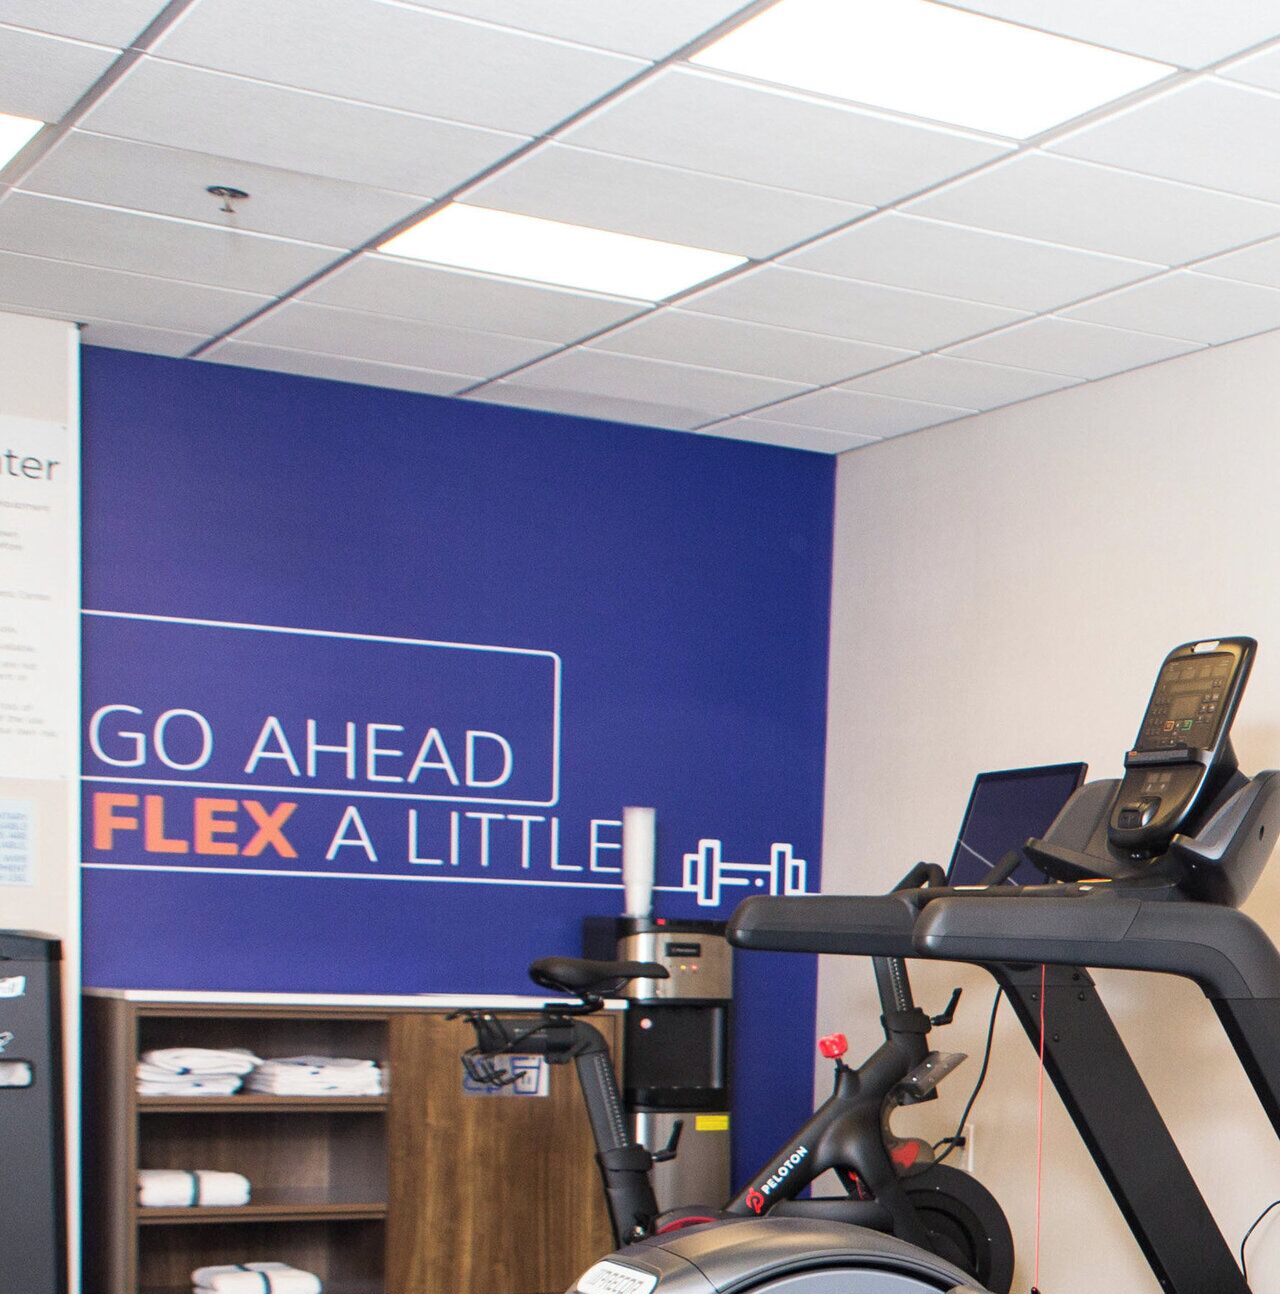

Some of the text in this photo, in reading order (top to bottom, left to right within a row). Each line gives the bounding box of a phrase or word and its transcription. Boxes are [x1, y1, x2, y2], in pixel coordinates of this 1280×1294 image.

[0, 448, 61, 481] ter
[88, 704, 514, 788] GO AHEAD
[93, 791, 298, 858] FLEX
[325, 805, 378, 862] A
[408, 808, 622, 873] LITTLE
[761, 1145, 808, 1195] PELOTON
